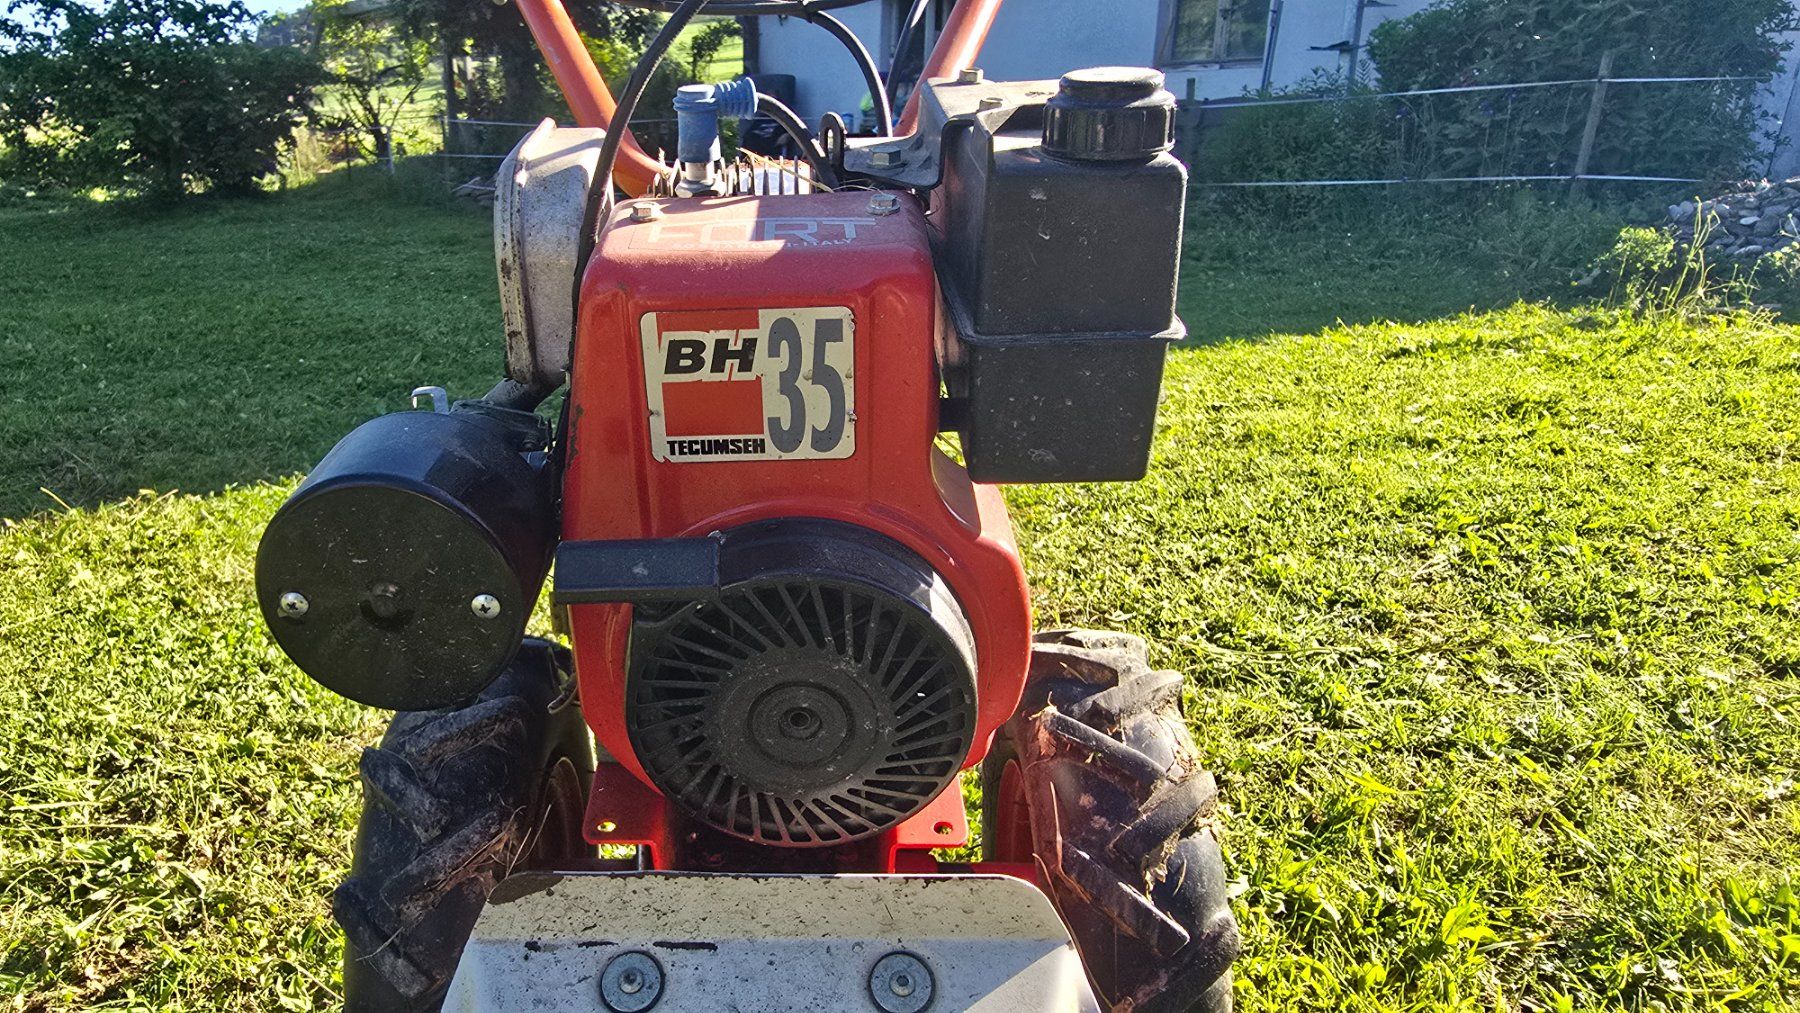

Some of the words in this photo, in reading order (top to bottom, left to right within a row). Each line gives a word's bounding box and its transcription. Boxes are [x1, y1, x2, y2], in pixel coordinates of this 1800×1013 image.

[648, 217, 876, 244] FORT
[664, 338, 758, 374] BH
[767, 316, 846, 454] 35
[666, 438, 766, 455] TECUMSEH
